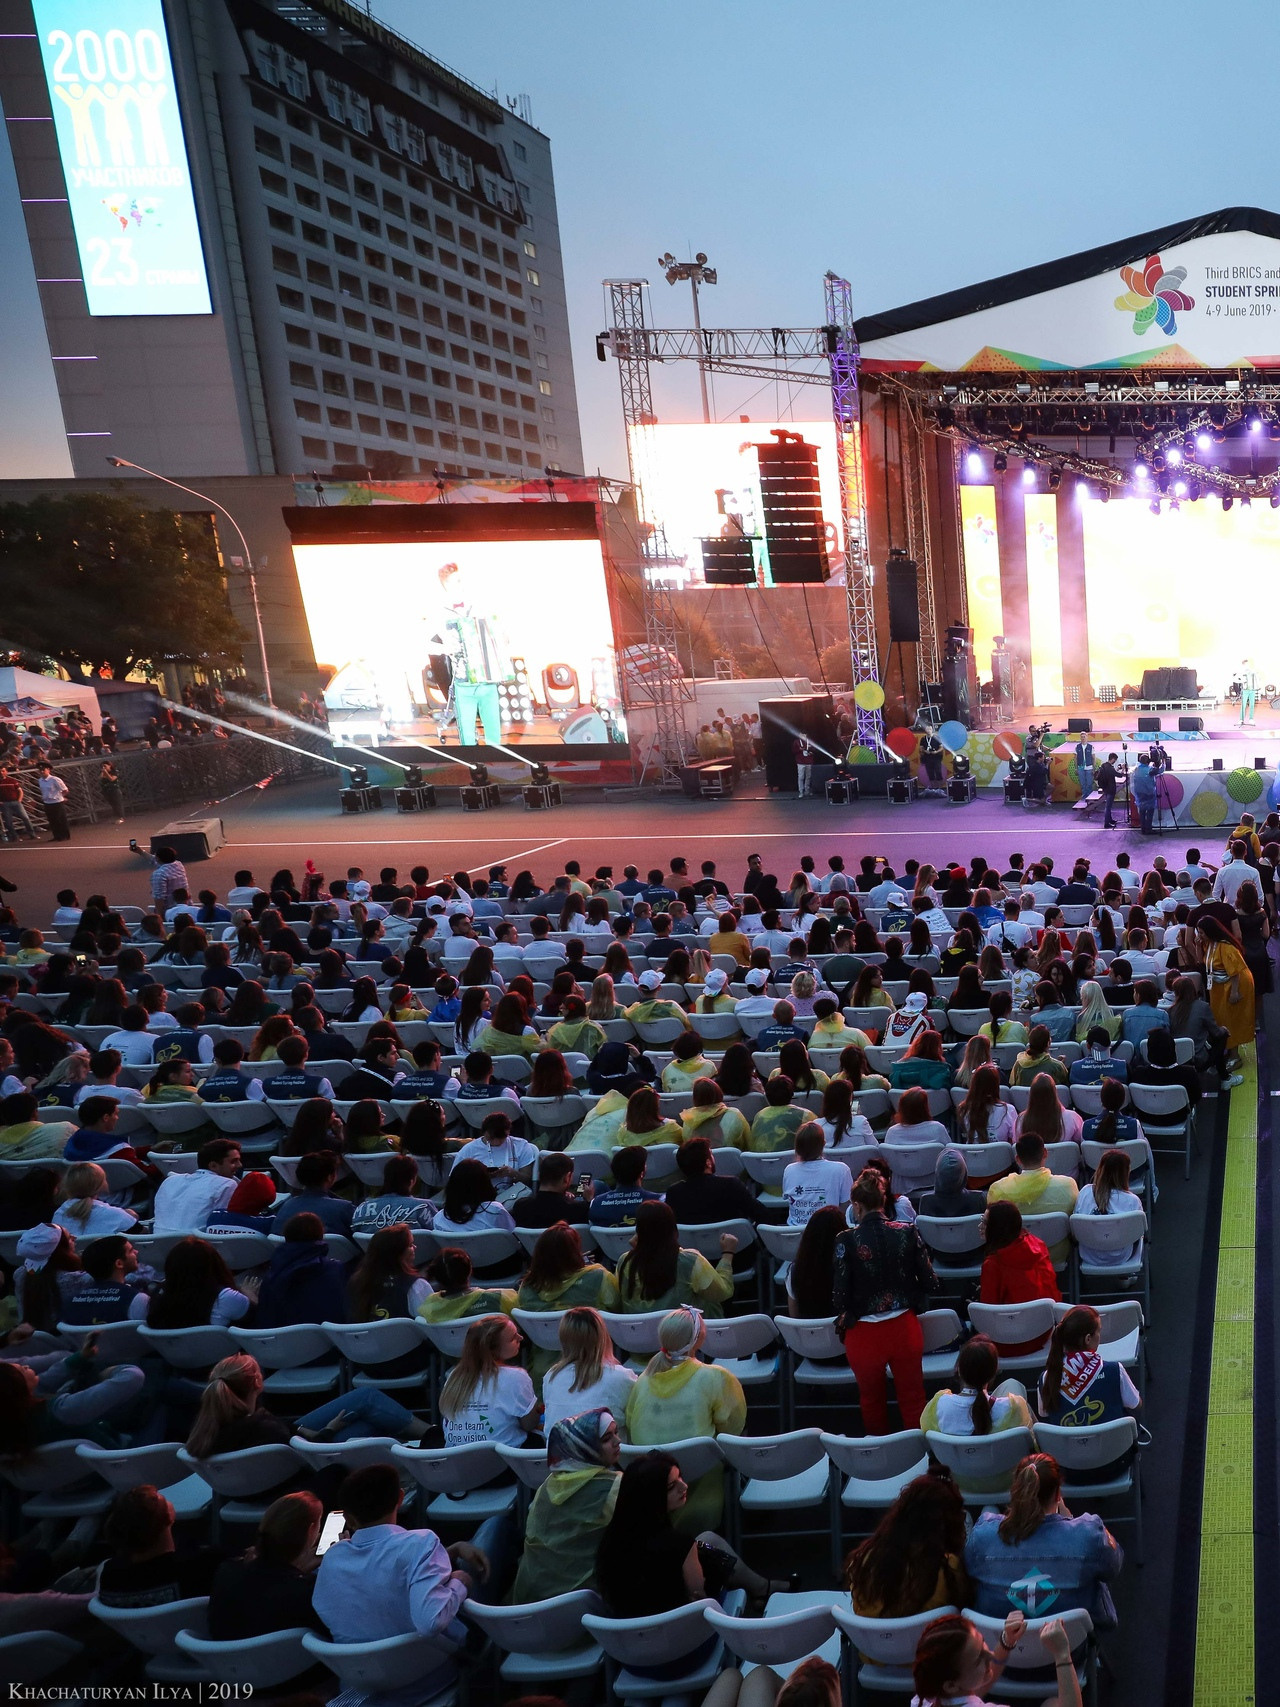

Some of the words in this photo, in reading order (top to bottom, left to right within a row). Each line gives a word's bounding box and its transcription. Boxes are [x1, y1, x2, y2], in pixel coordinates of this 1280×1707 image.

[47, 29, 166, 83] 2000
[71, 167, 185, 188] УЧАСТНИКОВ
[86, 236, 140, 287] 23
[1205, 266, 1230, 279] Third
[1232, 266, 1262, 279] BRICS
[1205, 286, 1252, 298] STUDENT
[1205, 305, 1222, 317] 4-9
[1224, 304, 1247, 316] June
[1249, 304, 1271, 316] 2019
[449, 1420, 463, 1431] One
[465, 1422, 484, 1431] team
[448, 1433, 462, 1443] One
[464, 1432, 487, 1442] vision
